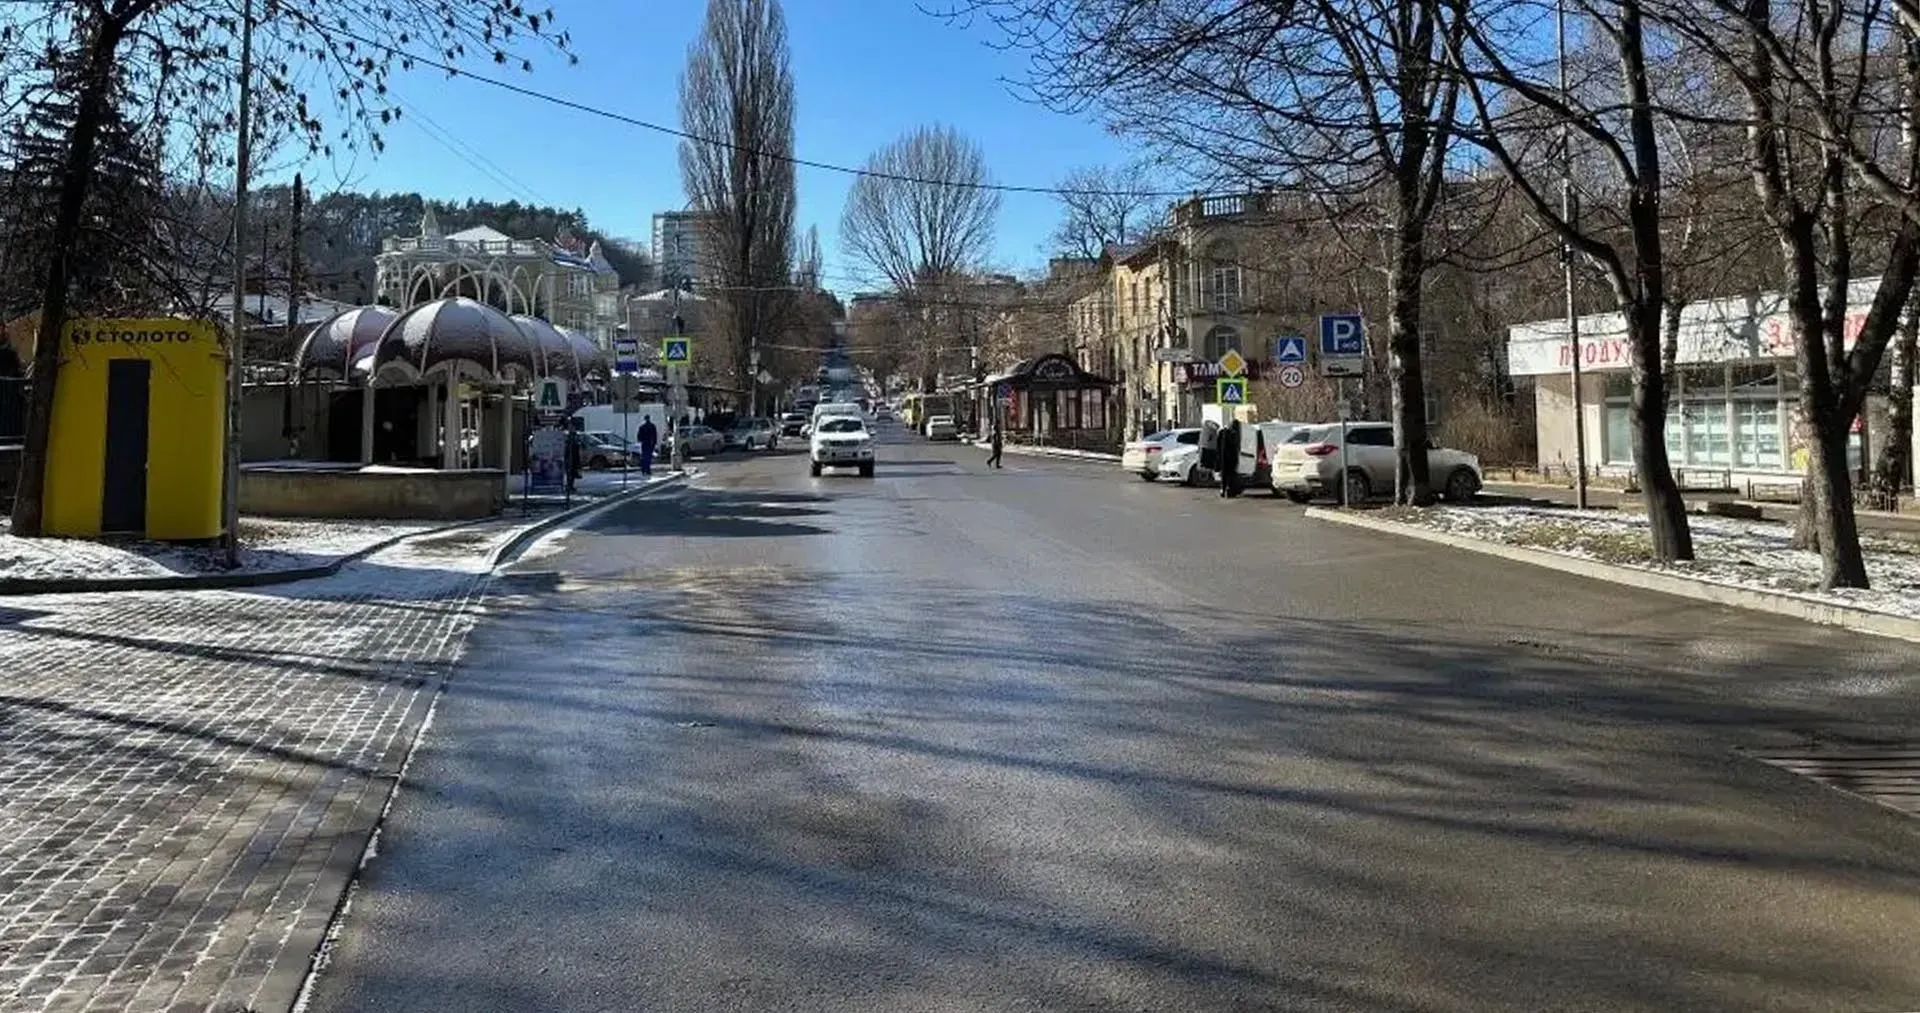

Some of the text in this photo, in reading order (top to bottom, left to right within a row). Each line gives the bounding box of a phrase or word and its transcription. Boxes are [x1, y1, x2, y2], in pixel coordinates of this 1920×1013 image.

[96, 330, 190, 342] СТОЛОТО
[1333, 320, 1355, 351] P
[1559, 340, 1623, 366] ПОДУ
[1284, 372, 1300, 383] 20
